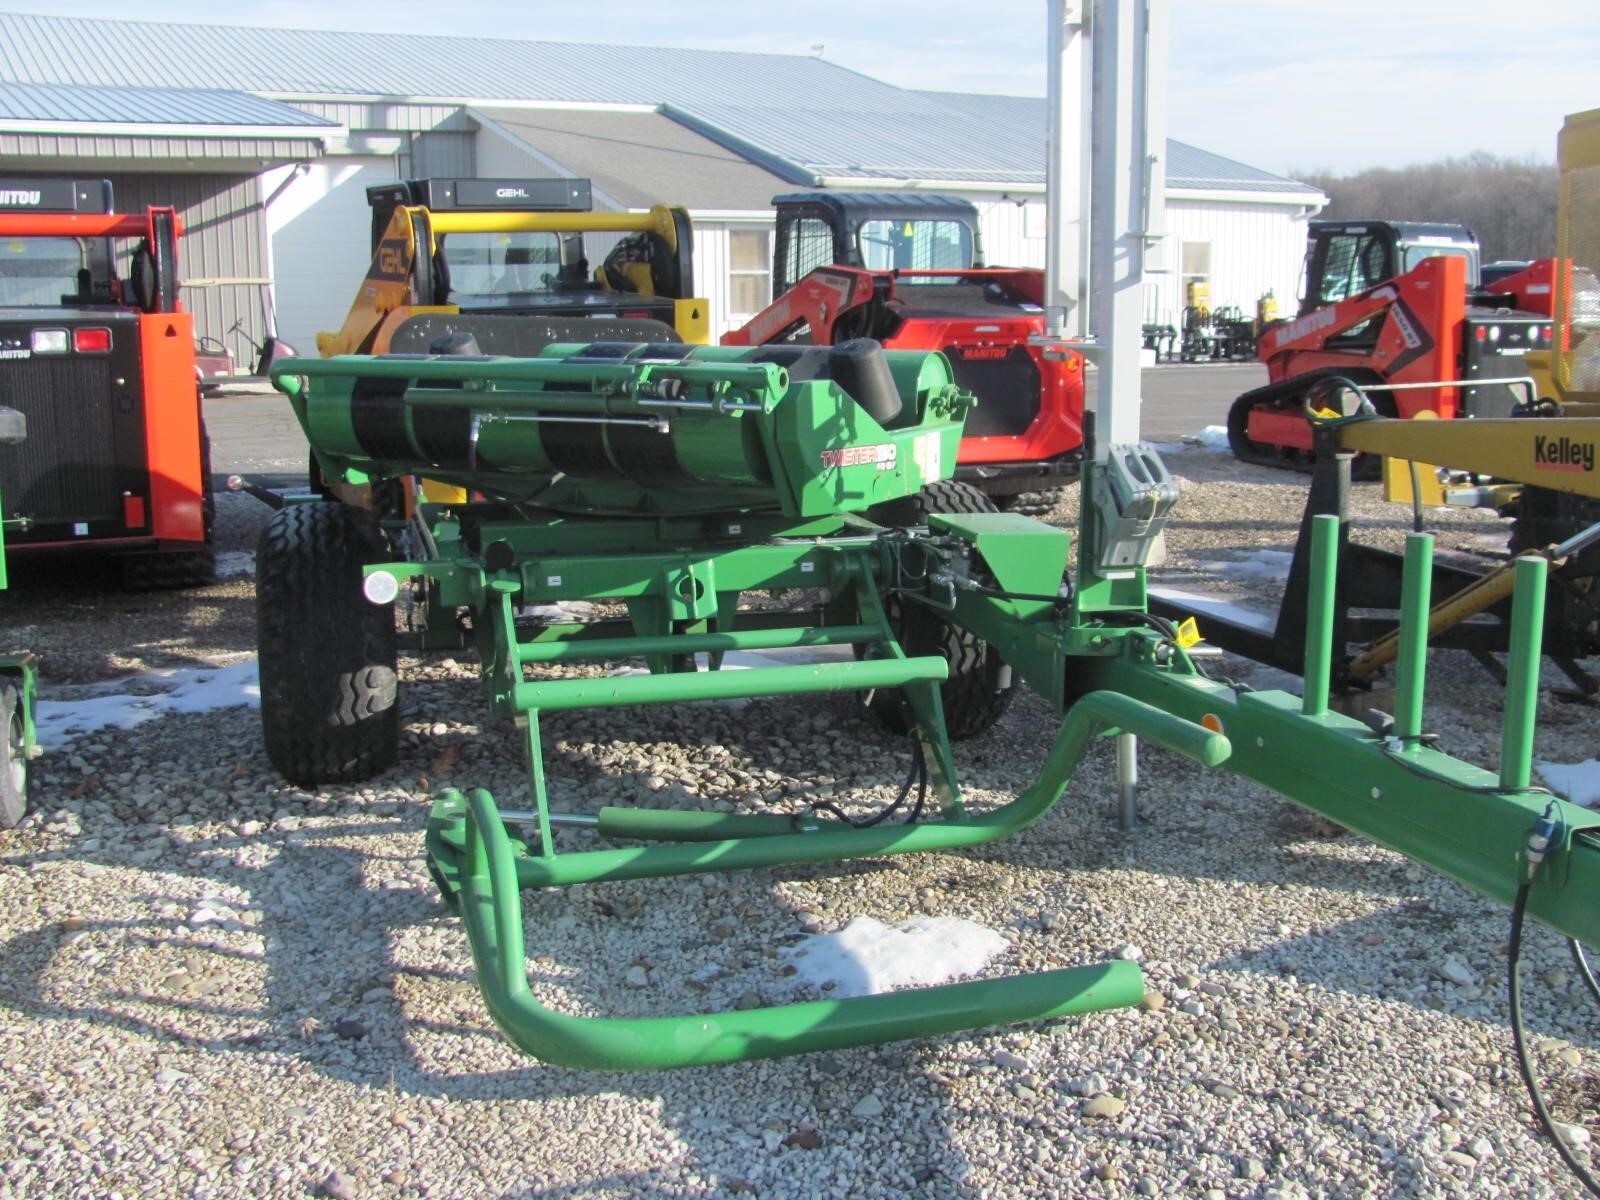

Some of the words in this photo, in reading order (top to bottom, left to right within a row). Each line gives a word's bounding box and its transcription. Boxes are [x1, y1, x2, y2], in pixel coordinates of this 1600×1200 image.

[496, 188, 530, 198] GEHL
[963, 348, 1007, 359] MANITOU
[821, 445, 877, 468] TWISTER
[1535, 435, 1594, 472] Kelley
